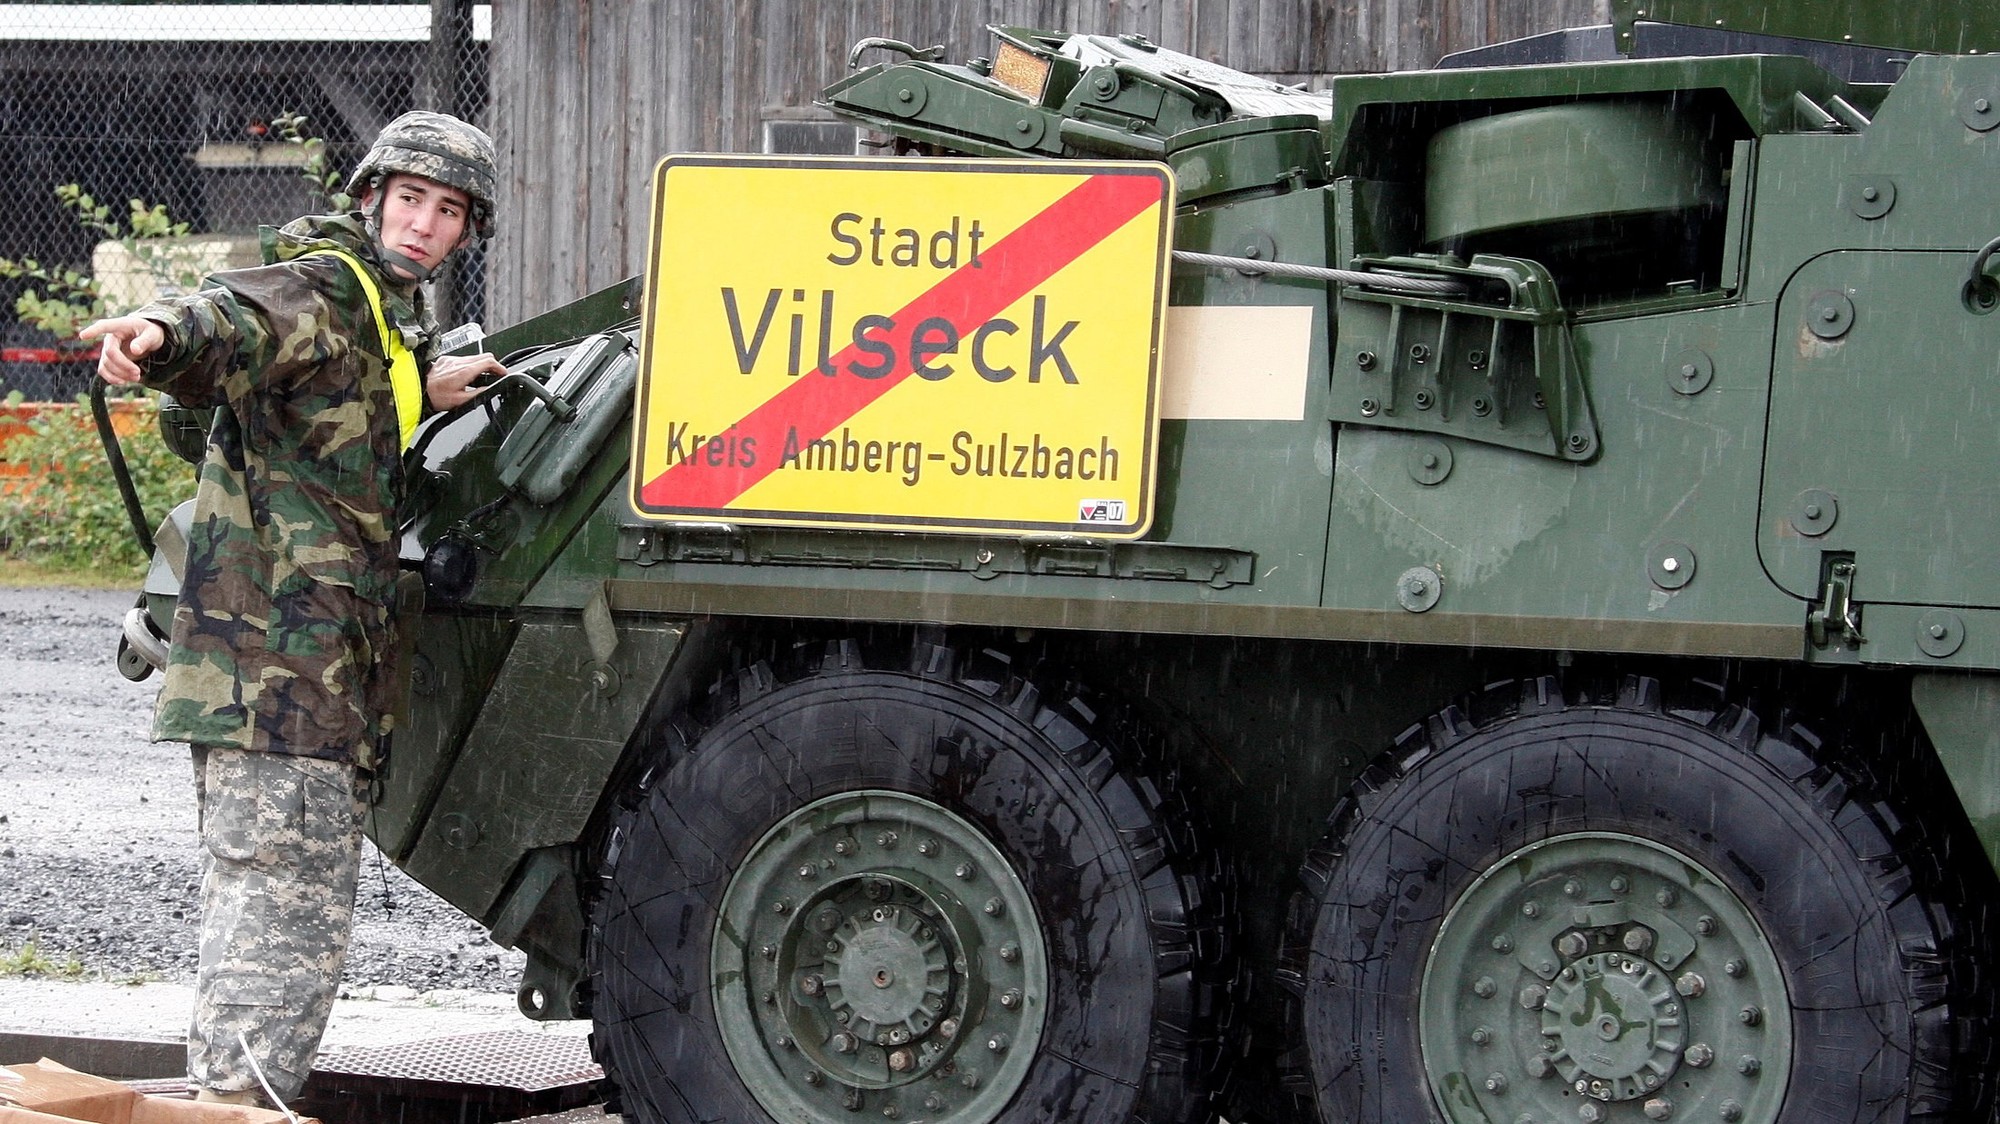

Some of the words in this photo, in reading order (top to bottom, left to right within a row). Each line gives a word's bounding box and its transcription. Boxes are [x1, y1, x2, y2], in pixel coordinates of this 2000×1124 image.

[826, 212, 984, 269] Stadt
[720, 287, 1081, 385] Vilseck
[666, 421, 757, 469] Kreis
[778, 426, 1119, 487] Amberg-Sulzbach
[1109, 502, 1123, 520] 07
